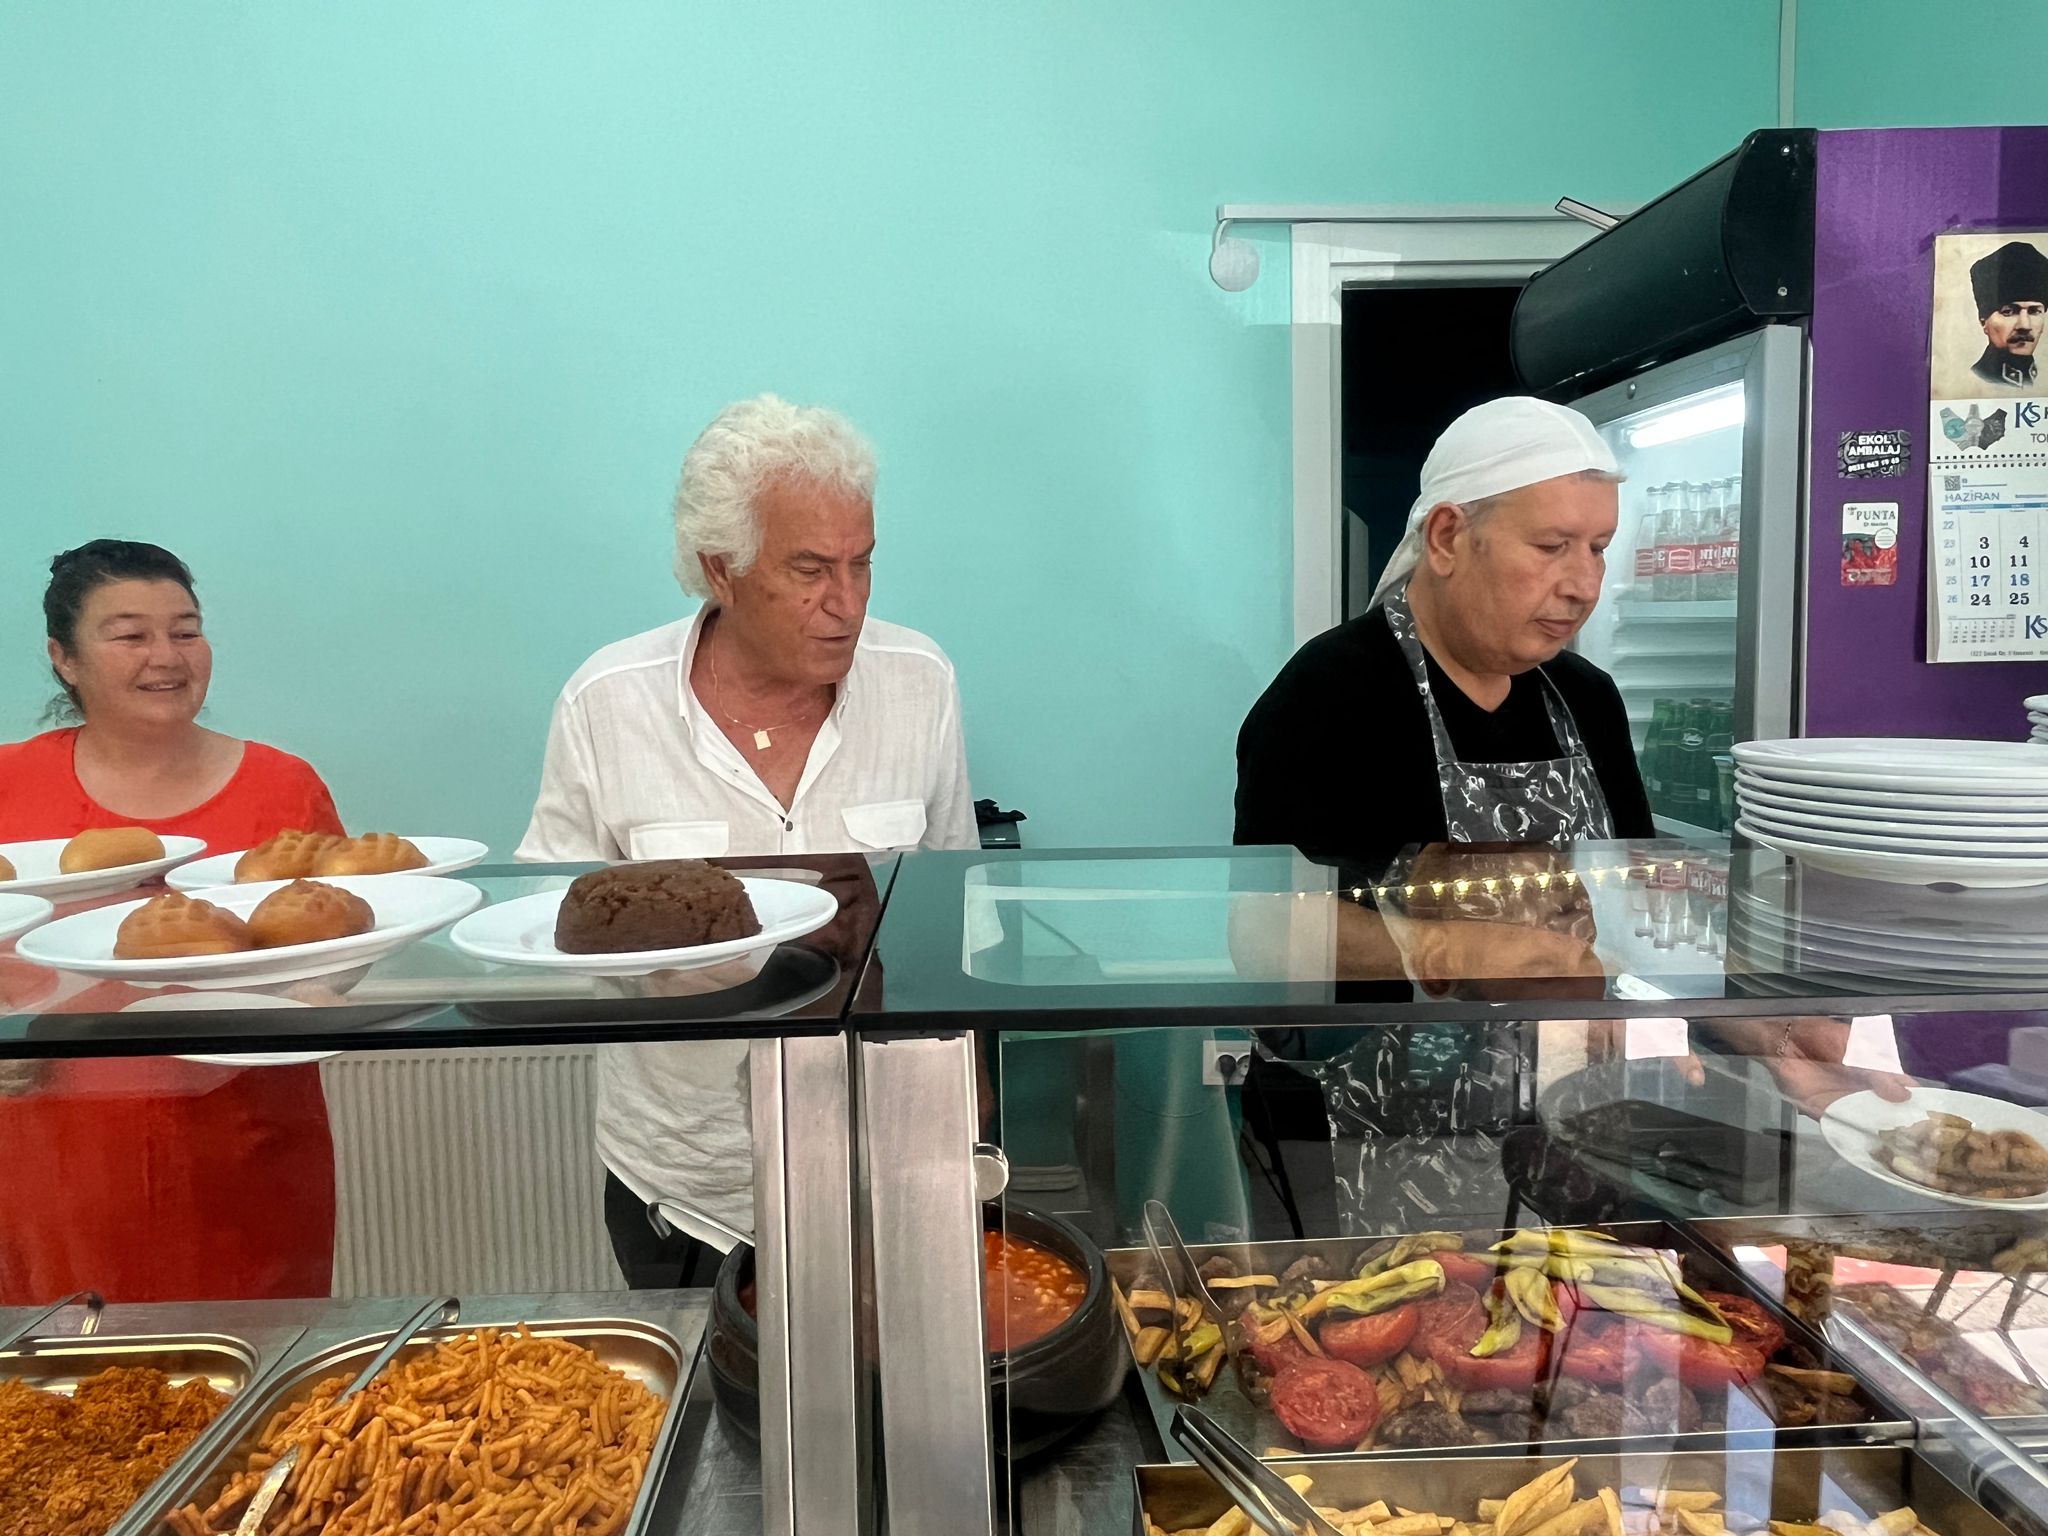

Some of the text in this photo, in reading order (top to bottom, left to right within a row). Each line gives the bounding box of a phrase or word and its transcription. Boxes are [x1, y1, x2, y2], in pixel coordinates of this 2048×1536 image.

[1858, 434, 1891, 445] EKOL
[2030, 433, 2048, 443] TO
[1848, 444, 1901, 456] AMBALAJ
[1945, 490, 2000, 502] HAZİRAN
[1856, 510, 1896, 520] PUNTA
[1942, 521, 1954, 530] 22
[1943, 536, 2029, 549] 23 3 4
[1721, 544, 1738, 558] Nİ
[1945, 555, 2028, 568] 24 10 11
[1946, 573, 2030, 587] 25 17 18
[1970, 594, 1991, 606] 24
[2009, 592, 2030, 605] 25
